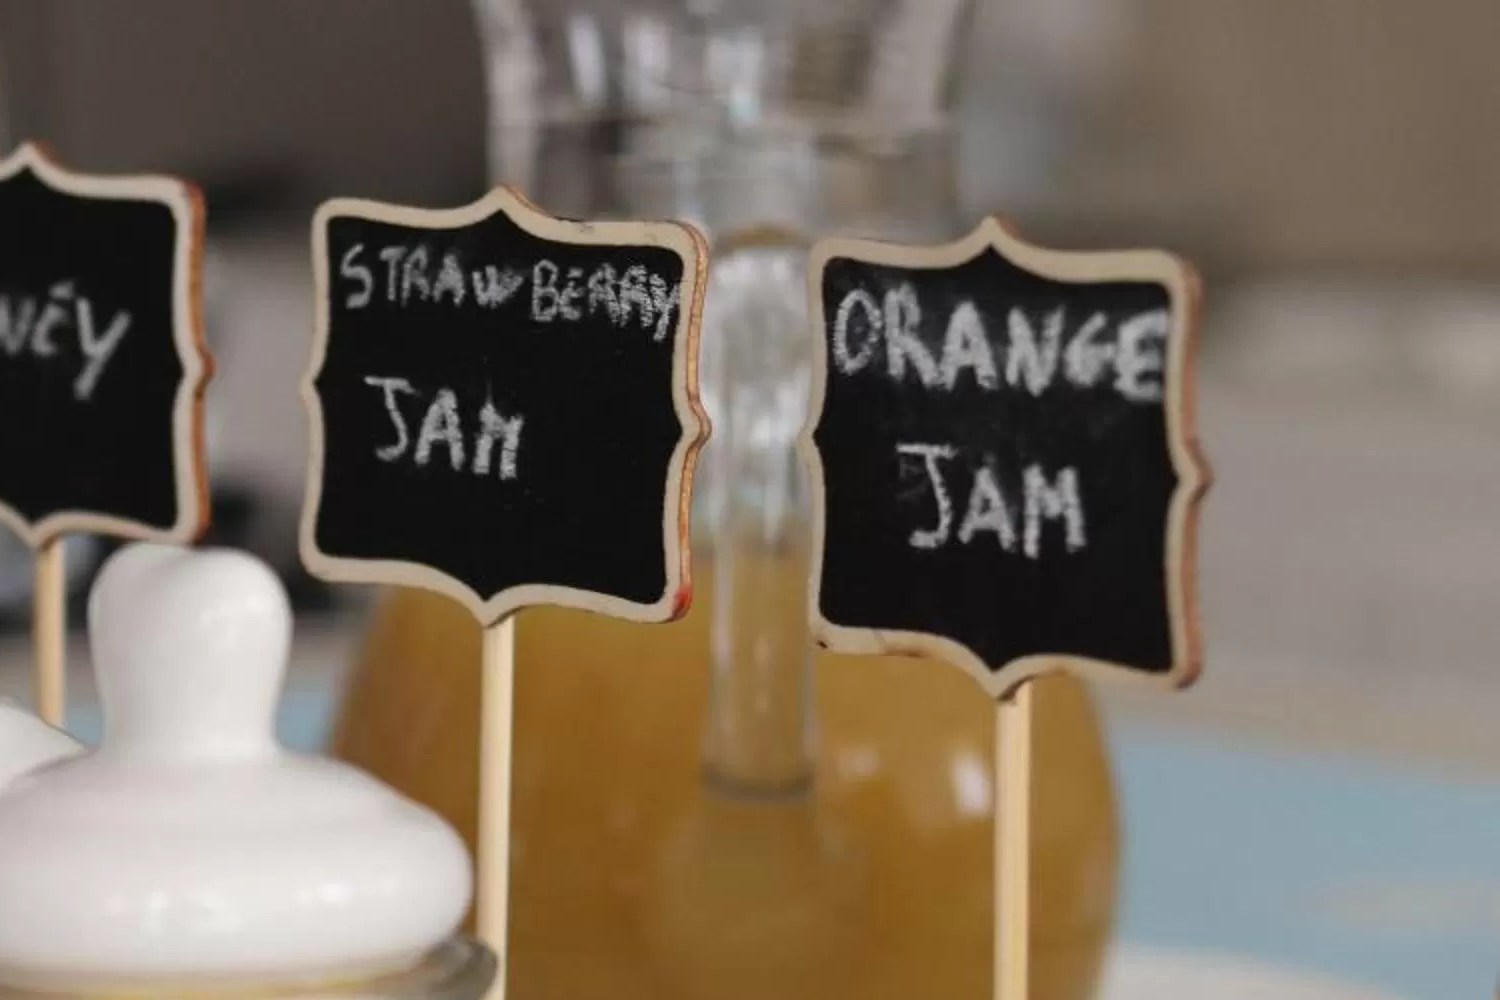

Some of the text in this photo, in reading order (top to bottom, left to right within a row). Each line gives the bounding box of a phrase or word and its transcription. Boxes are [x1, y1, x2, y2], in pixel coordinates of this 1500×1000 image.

[832, 281, 1171, 401] ORANGE
[364, 375, 524, 480] JAM
[895, 442, 1088, 559] JAM
